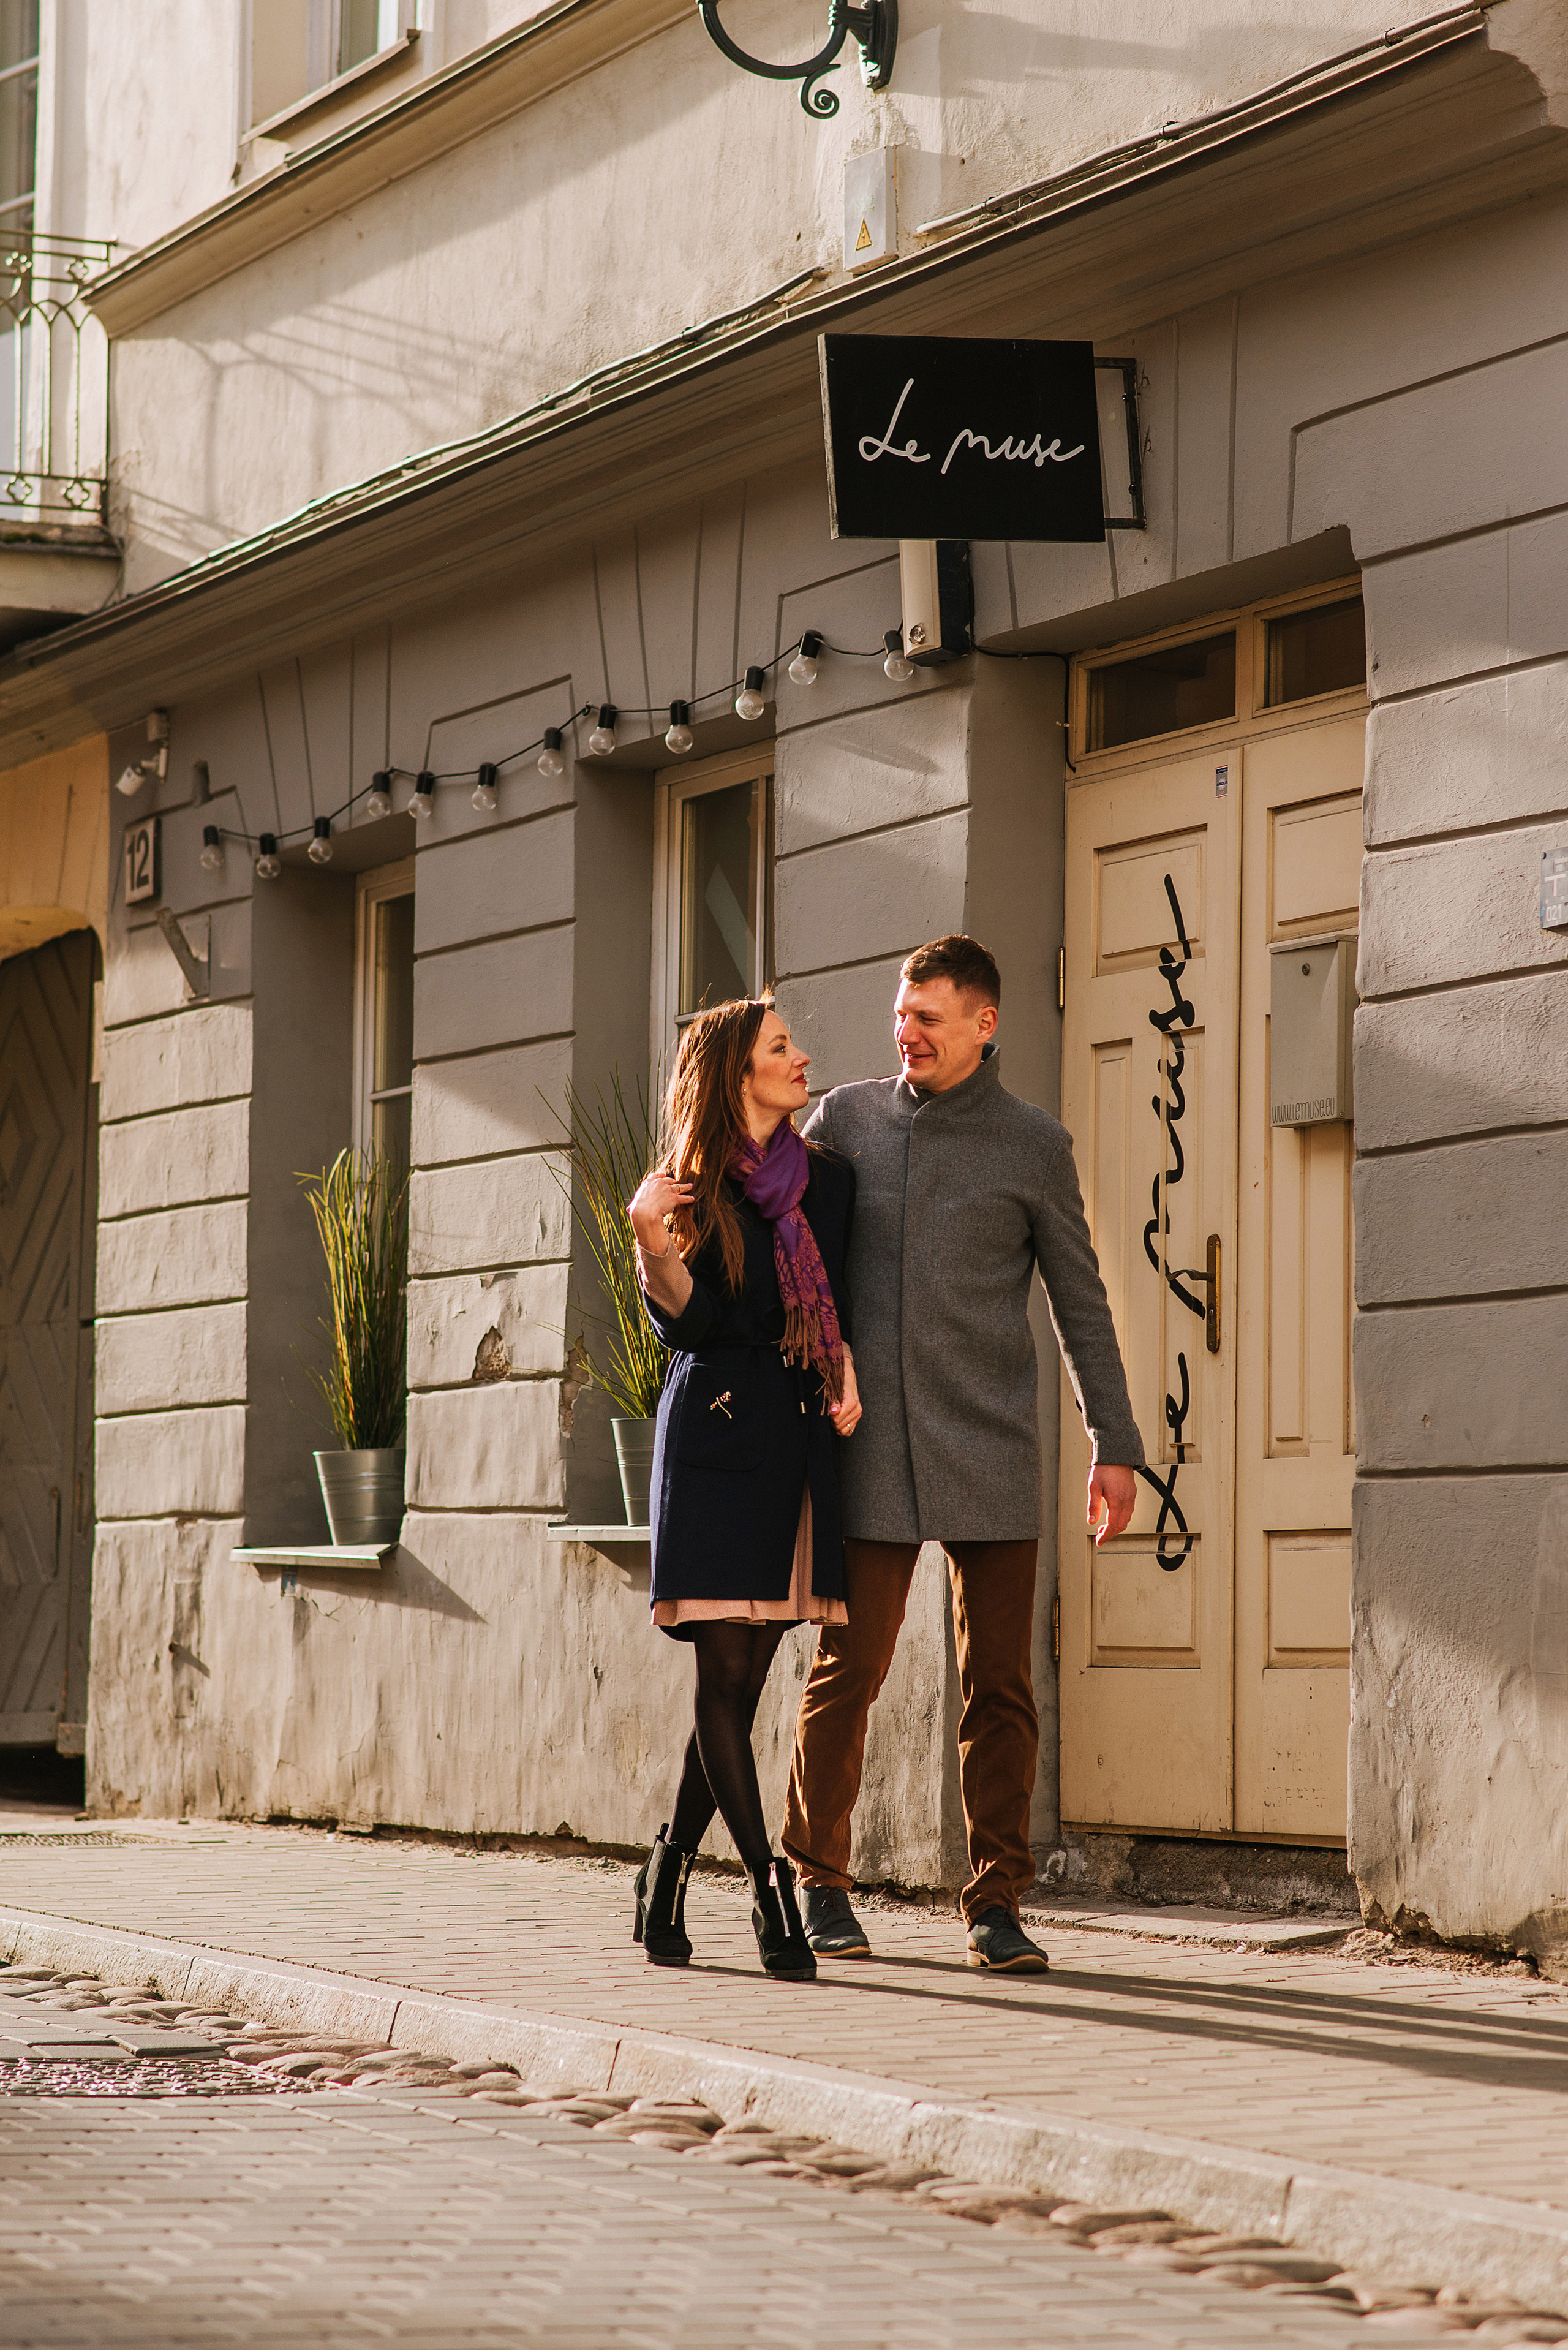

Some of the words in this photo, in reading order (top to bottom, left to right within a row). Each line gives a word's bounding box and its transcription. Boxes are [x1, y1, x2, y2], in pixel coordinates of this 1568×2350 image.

[859, 378, 930, 463] Le
[941, 429, 1085, 474] muse
[127, 829, 149, 891] 12
[1546, 903, 1562, 921] 021
[1272, 1097, 1335, 1124] www.lemuse.eu
